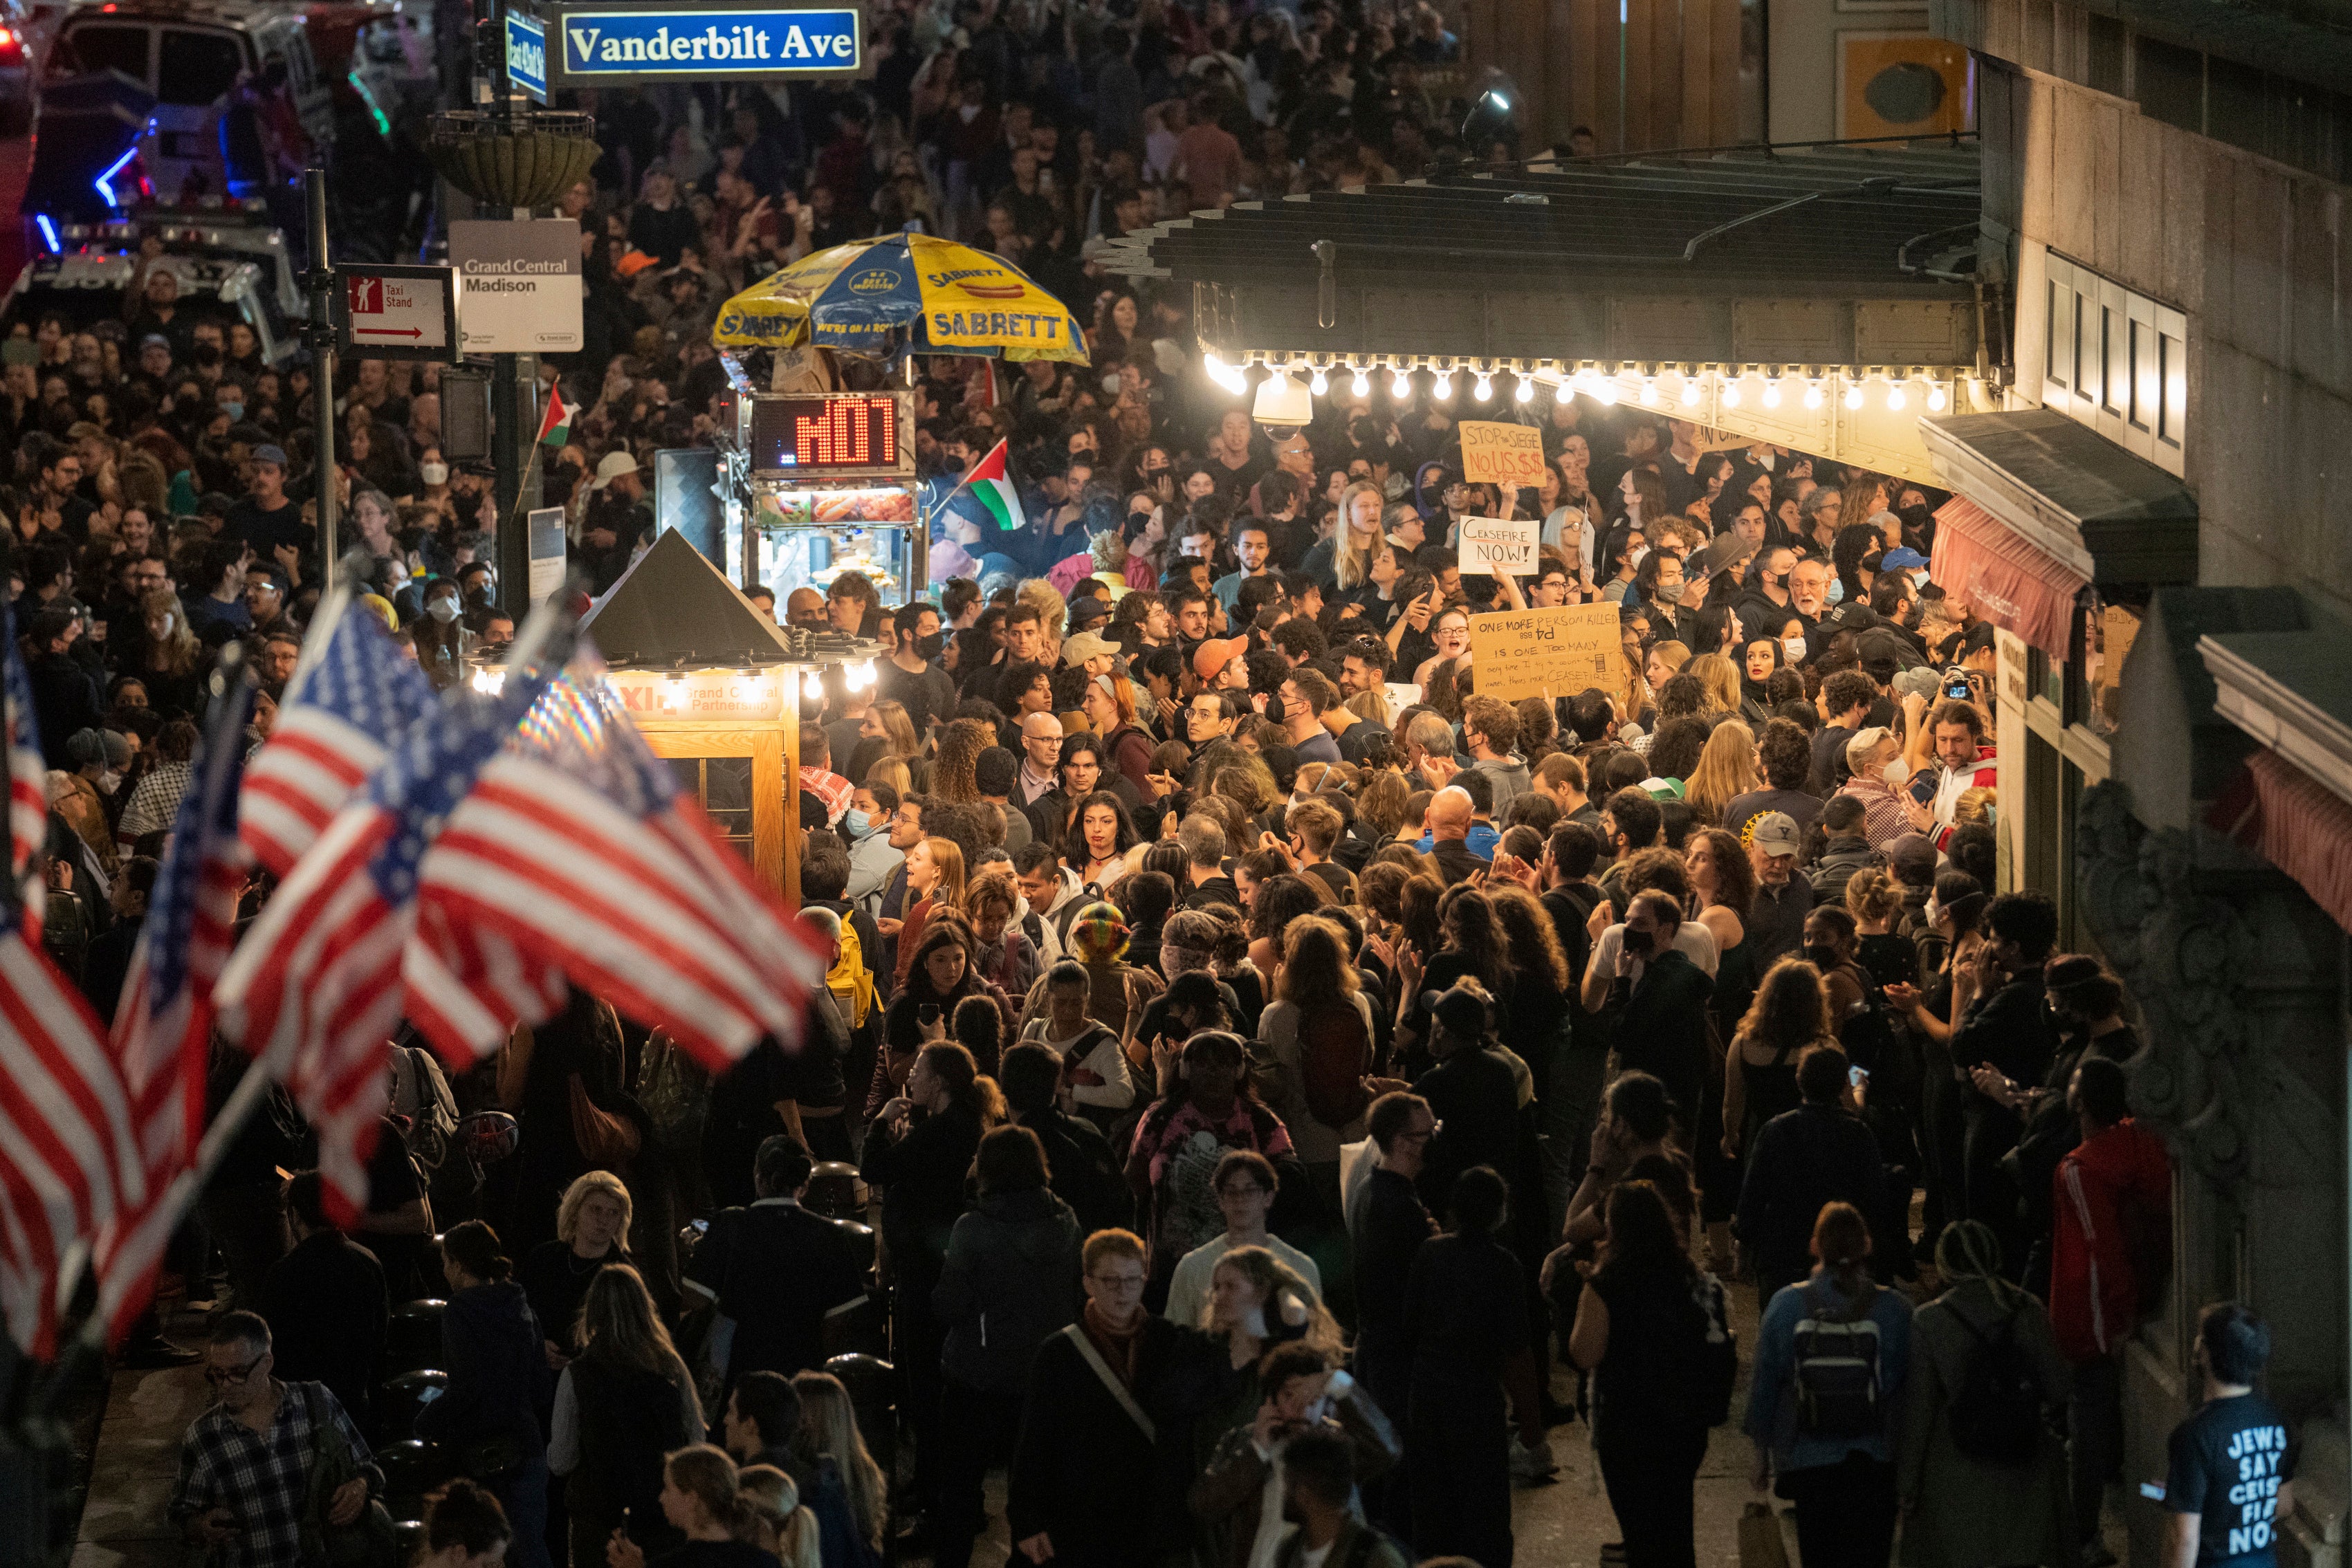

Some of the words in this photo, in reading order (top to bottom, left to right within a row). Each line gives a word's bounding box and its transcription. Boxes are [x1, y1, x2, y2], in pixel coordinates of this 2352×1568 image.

[569, 26, 770, 62] Vanderbilt
[780, 25, 852, 58] Ave
[465, 259, 511, 273] Grand
[514, 259, 567, 273] Central
[466, 279, 536, 292] Madison
[928, 270, 1003, 287] SABRETT
[386, 285, 403, 295] Taxi
[387, 297, 412, 307] Stand
[849, 324, 863, 333] ON
[864, 324, 871, 333] A
[935, 312, 1060, 338] SABRETT
[1466, 426, 1501, 445] STOP
[1509, 431, 1539, 448] SIEGE
[1469, 452, 1490, 472] NO
[1518, 452, 1543, 476] $$
[1463, 519, 1527, 542] CEASEFIRE
[1477, 544, 1530, 562] NOW!
[1479, 622, 1503, 633] ONE
[1506, 618, 1534, 630] MORE
[1537, 616, 1582, 629] PERSON
[1588, 614, 1617, 625] KILLED
[1495, 649, 1507, 658] IS
[1514, 647, 1538, 656] ONE
[1544, 645, 1565, 654] TOO
[1568, 640, 1599, 651] MANY
[1487, 666, 1502, 675] every
[1547, 670, 1613, 683] CEASEFIRE
[1778, 827, 1790, 840] Y
[2227, 1426, 2287, 1459] JEWS
[2239, 1451, 2281, 1482] SAY
